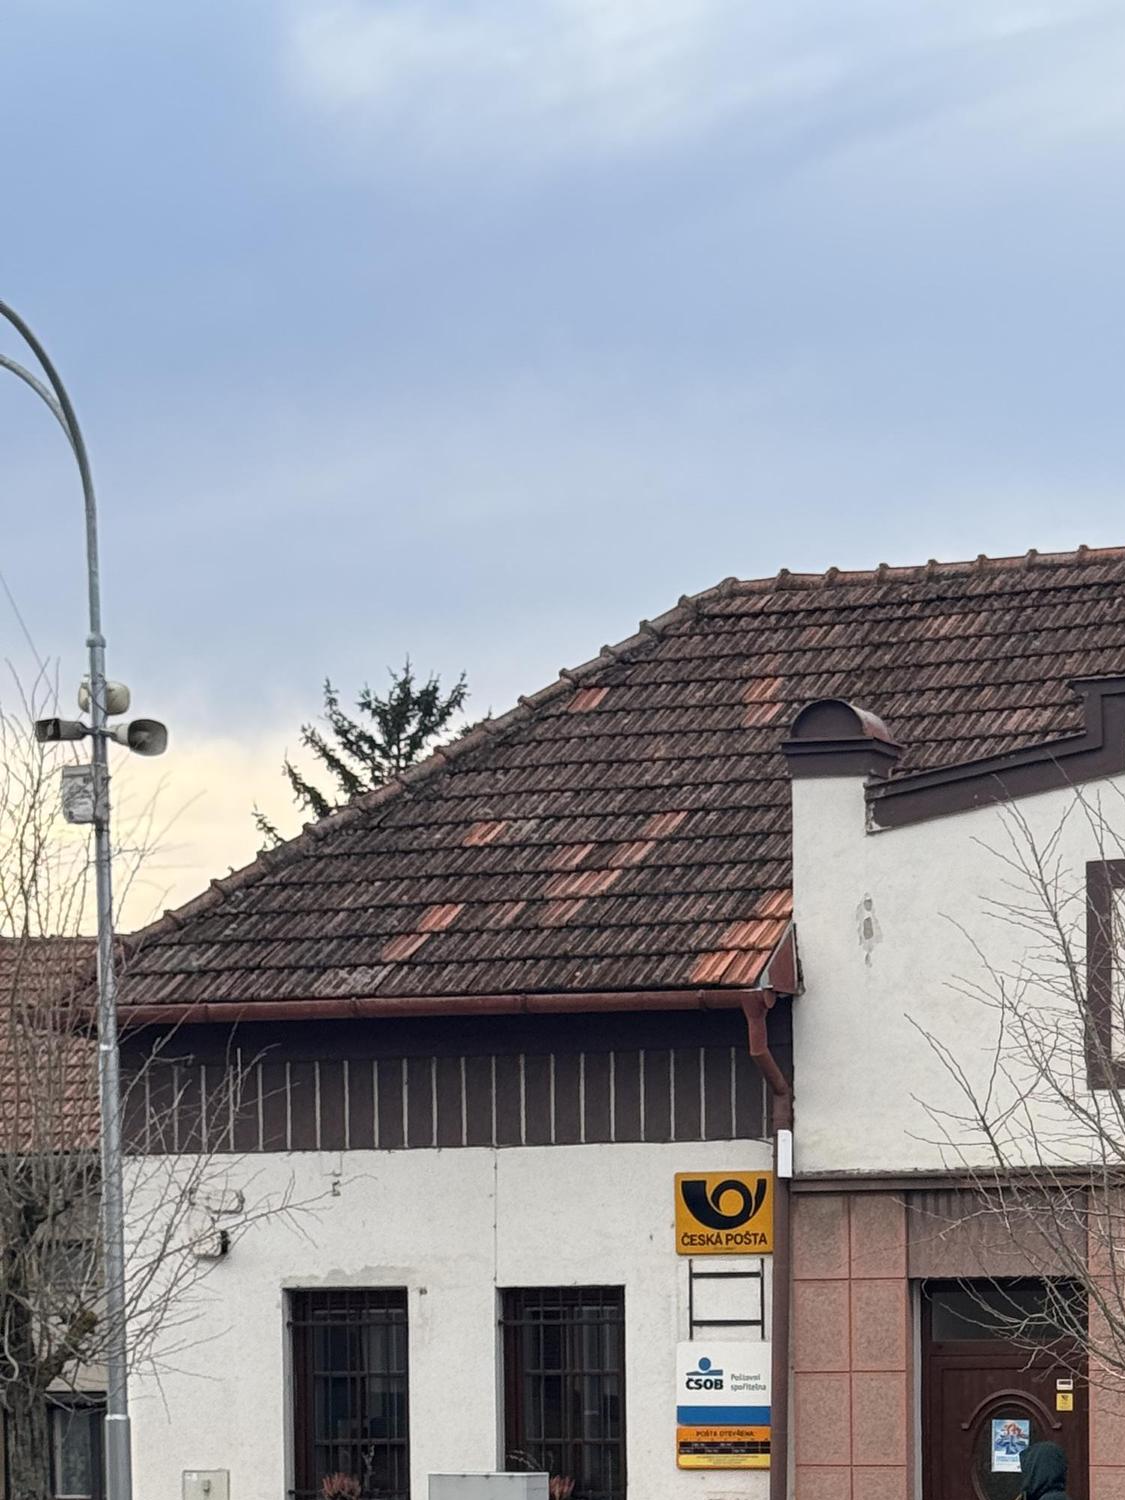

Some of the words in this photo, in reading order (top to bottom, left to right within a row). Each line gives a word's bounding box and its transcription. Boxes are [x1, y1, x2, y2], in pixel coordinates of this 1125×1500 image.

[681, 1232, 723, 1246] ČESKÁ
[725, 1231, 768, 1246] POŠTA
[685, 1378, 724, 1391] ČSOB
[731, 1383, 767, 1392] spořitelna
